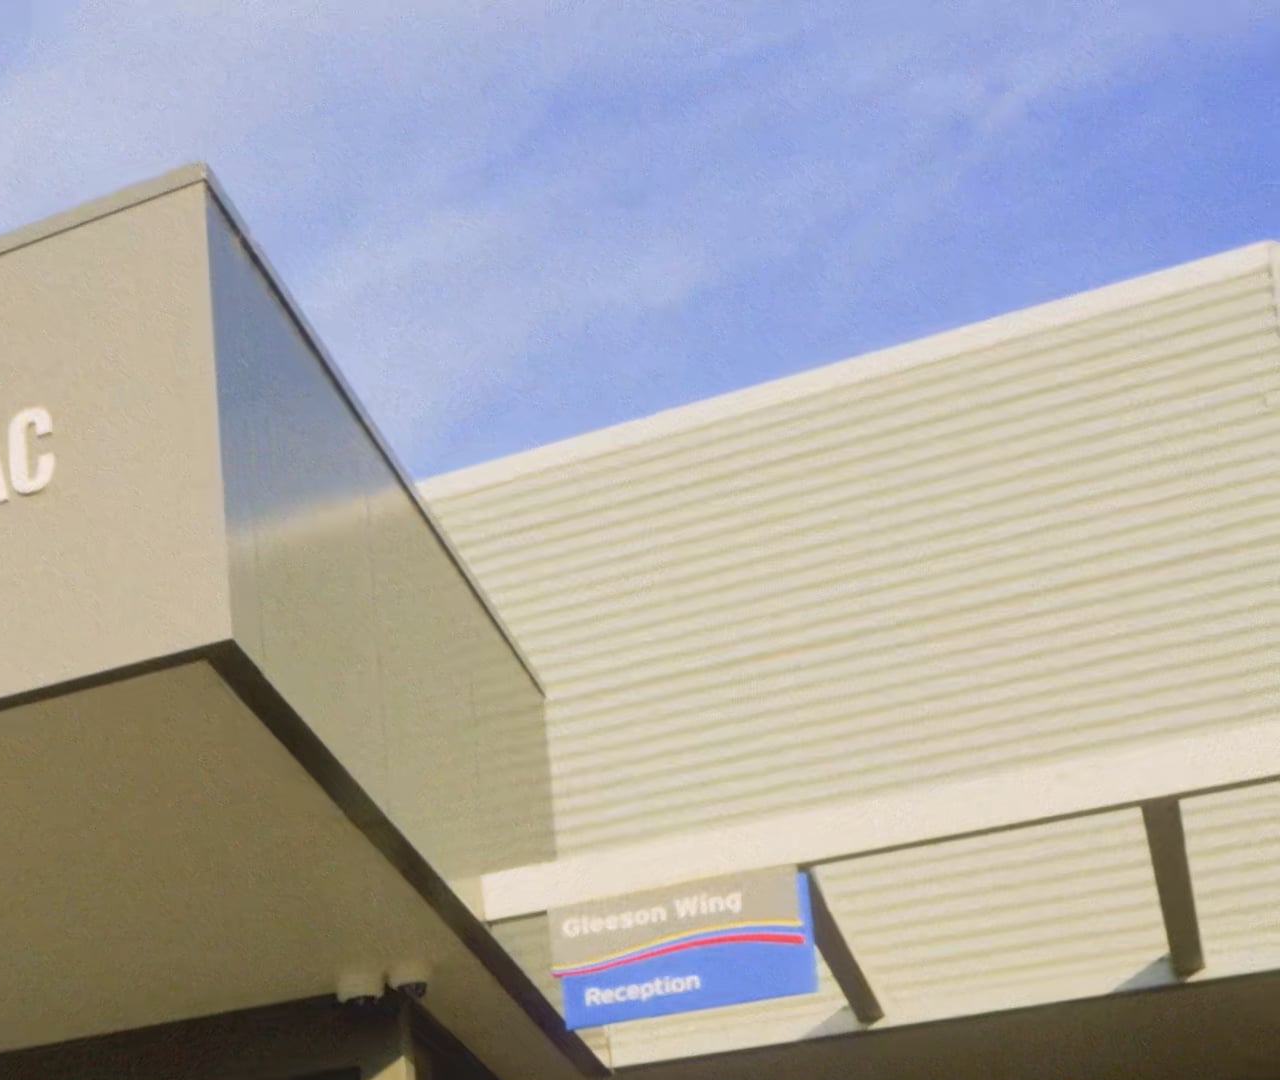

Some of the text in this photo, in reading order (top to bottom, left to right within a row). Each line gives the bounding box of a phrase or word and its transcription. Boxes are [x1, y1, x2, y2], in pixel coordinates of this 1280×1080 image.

[562, 892, 742, 938] Gleeson Wing
[585, 975, 701, 1006] Reception
